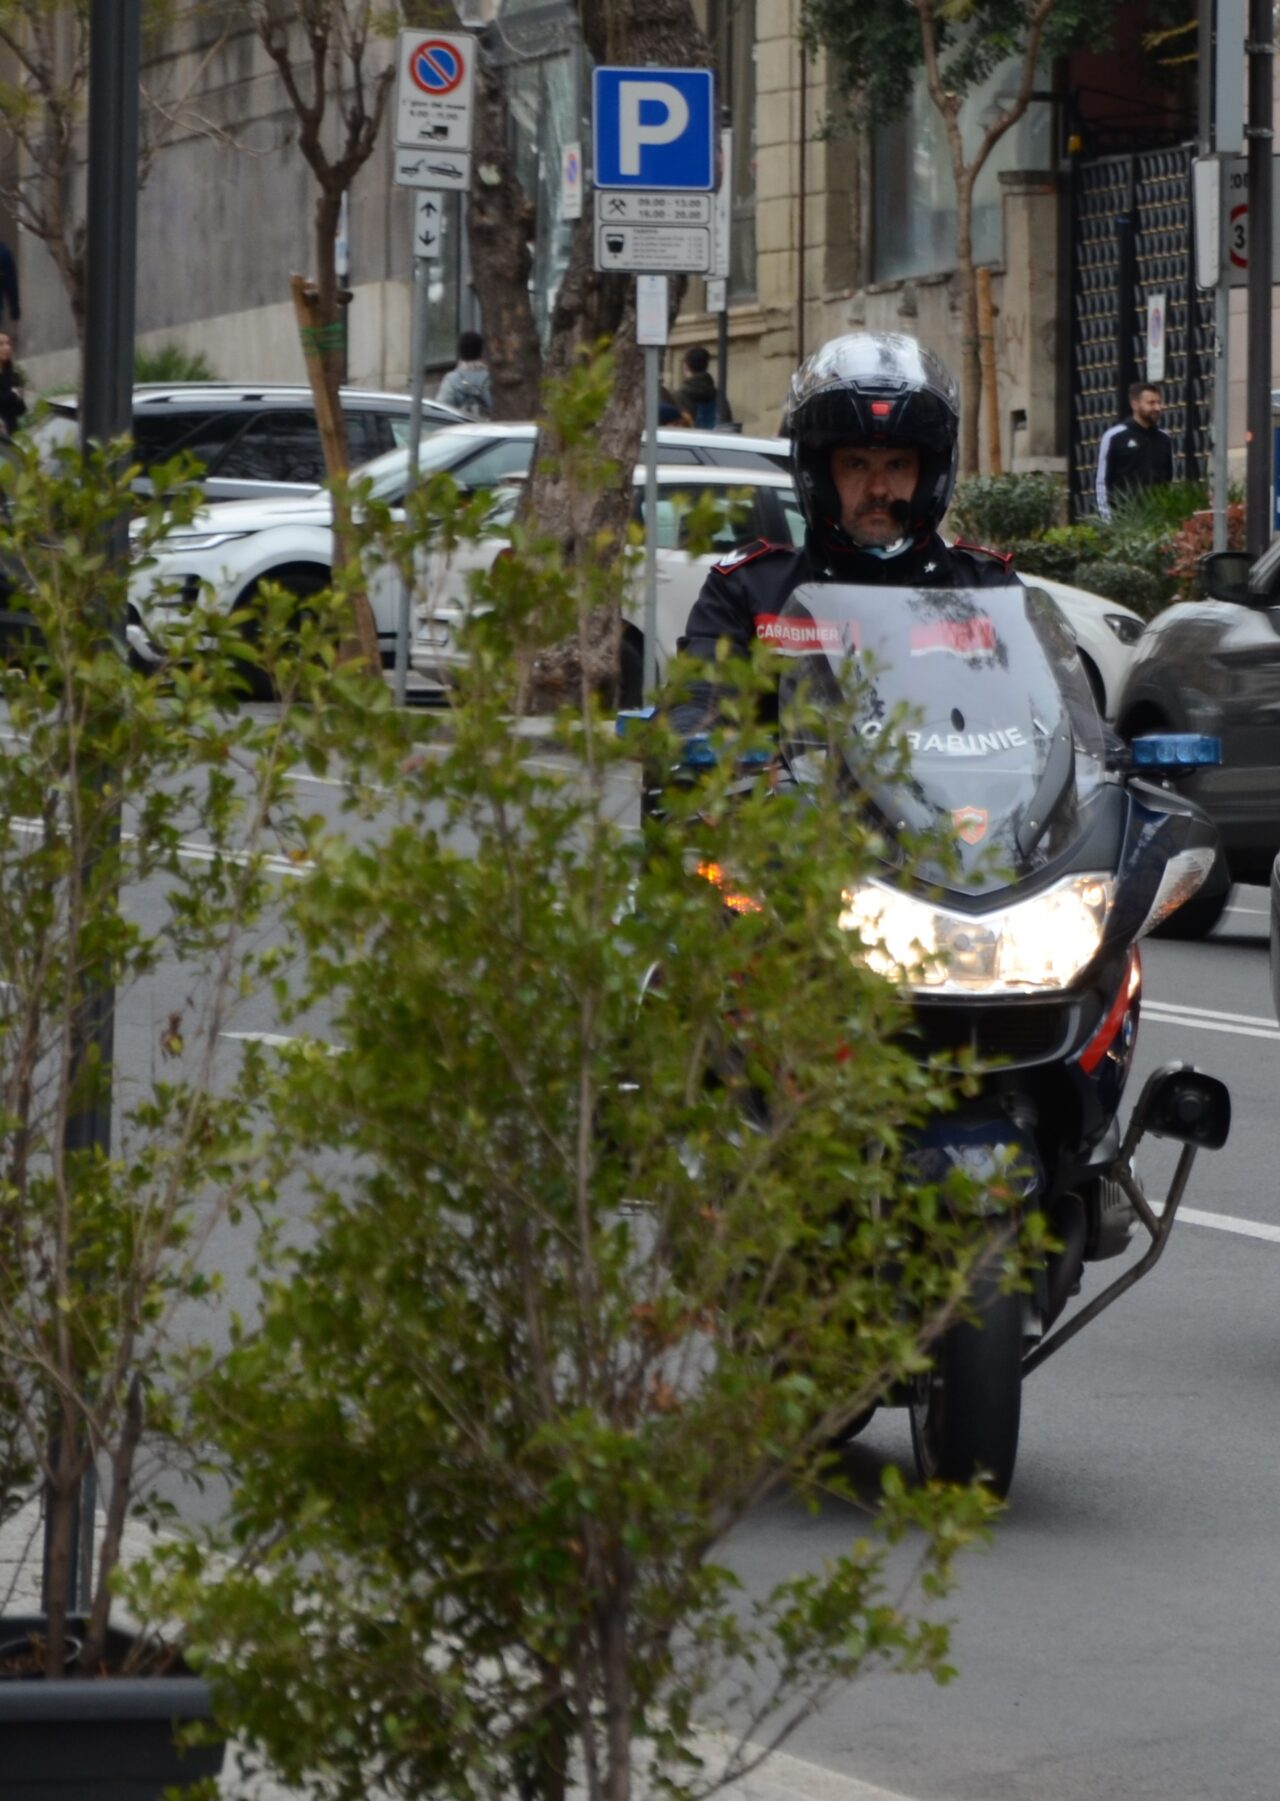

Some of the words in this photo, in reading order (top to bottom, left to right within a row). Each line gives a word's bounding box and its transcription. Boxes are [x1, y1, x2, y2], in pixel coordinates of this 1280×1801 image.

[619, 80, 690, 177] P
[1234, 224, 1246, 250] 3
[756, 623, 839, 642] CARABINIER
[860, 717, 1050, 753] CRABINIEI
